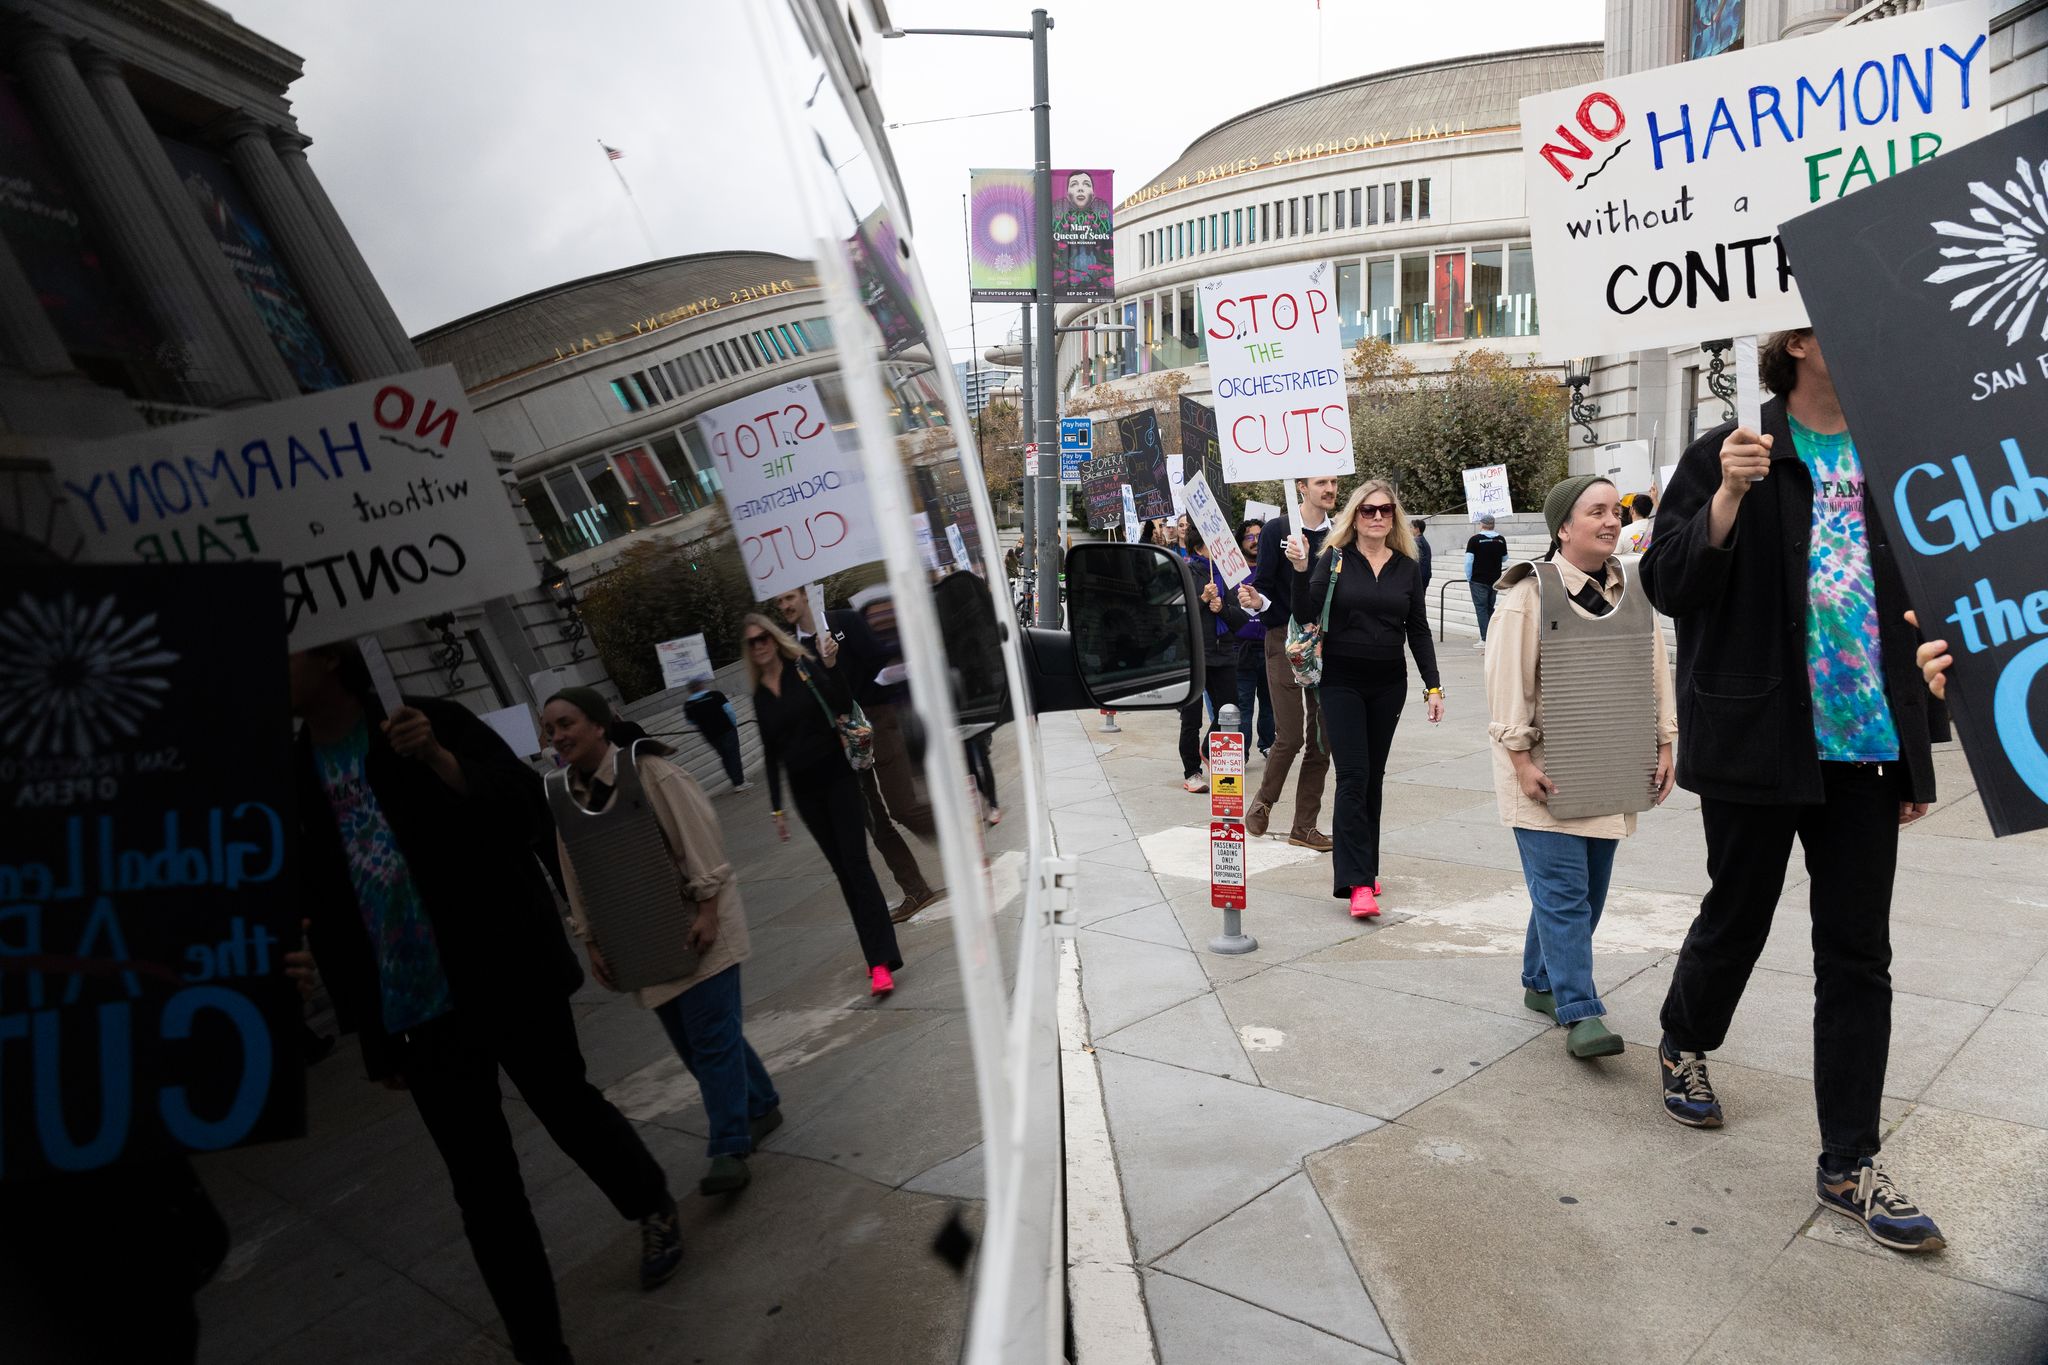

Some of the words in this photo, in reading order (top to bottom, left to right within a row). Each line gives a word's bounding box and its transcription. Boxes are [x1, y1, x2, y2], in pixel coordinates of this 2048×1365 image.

[1539, 91, 1626, 182] NO
[1646, 33, 1987, 171] HARMONY
[1124, 182, 1168, 209] LOUISE
[1178, 175, 1187, 189] M
[1197, 157, 1258, 184] DAVIES
[1273, 131, 1390, 166] SYMPHONY
[1410, 121, 1471, 142] HALL
[1566, 184, 1694, 240] without
[1733, 195, 1749, 213] a
[1053, 232, 1079, 241] Queen
[1089, 232, 1110, 240] Scots
[1208, 289, 1328, 339] STOP
[1243, 342, 1285, 364] THE
[1218, 368, 1339, 398] ORCHESTRATED
[1971, 362, 2027, 401] SAN
[1062, 421, 1074, 429] Pay
[1121, 416, 1144, 452] SF
[1232, 404, 1347, 456] CUTS
[1082, 460, 1095, 474] SF
[1097, 455, 1124, 470] OPERA
[1082, 469, 1122, 482] ORCHESTRA
[1482, 488, 1503, 502] ART
[1221, 547, 1247, 577] CUTS
[1945, 578, 2048, 654] the
[1211, 759, 1241, 767] MON-SAT
[1213, 841, 1242, 849] PASSENGER
[1217, 849, 1238, 857] LOADING
[1213, 871, 1243, 879] PERFORMANCES
